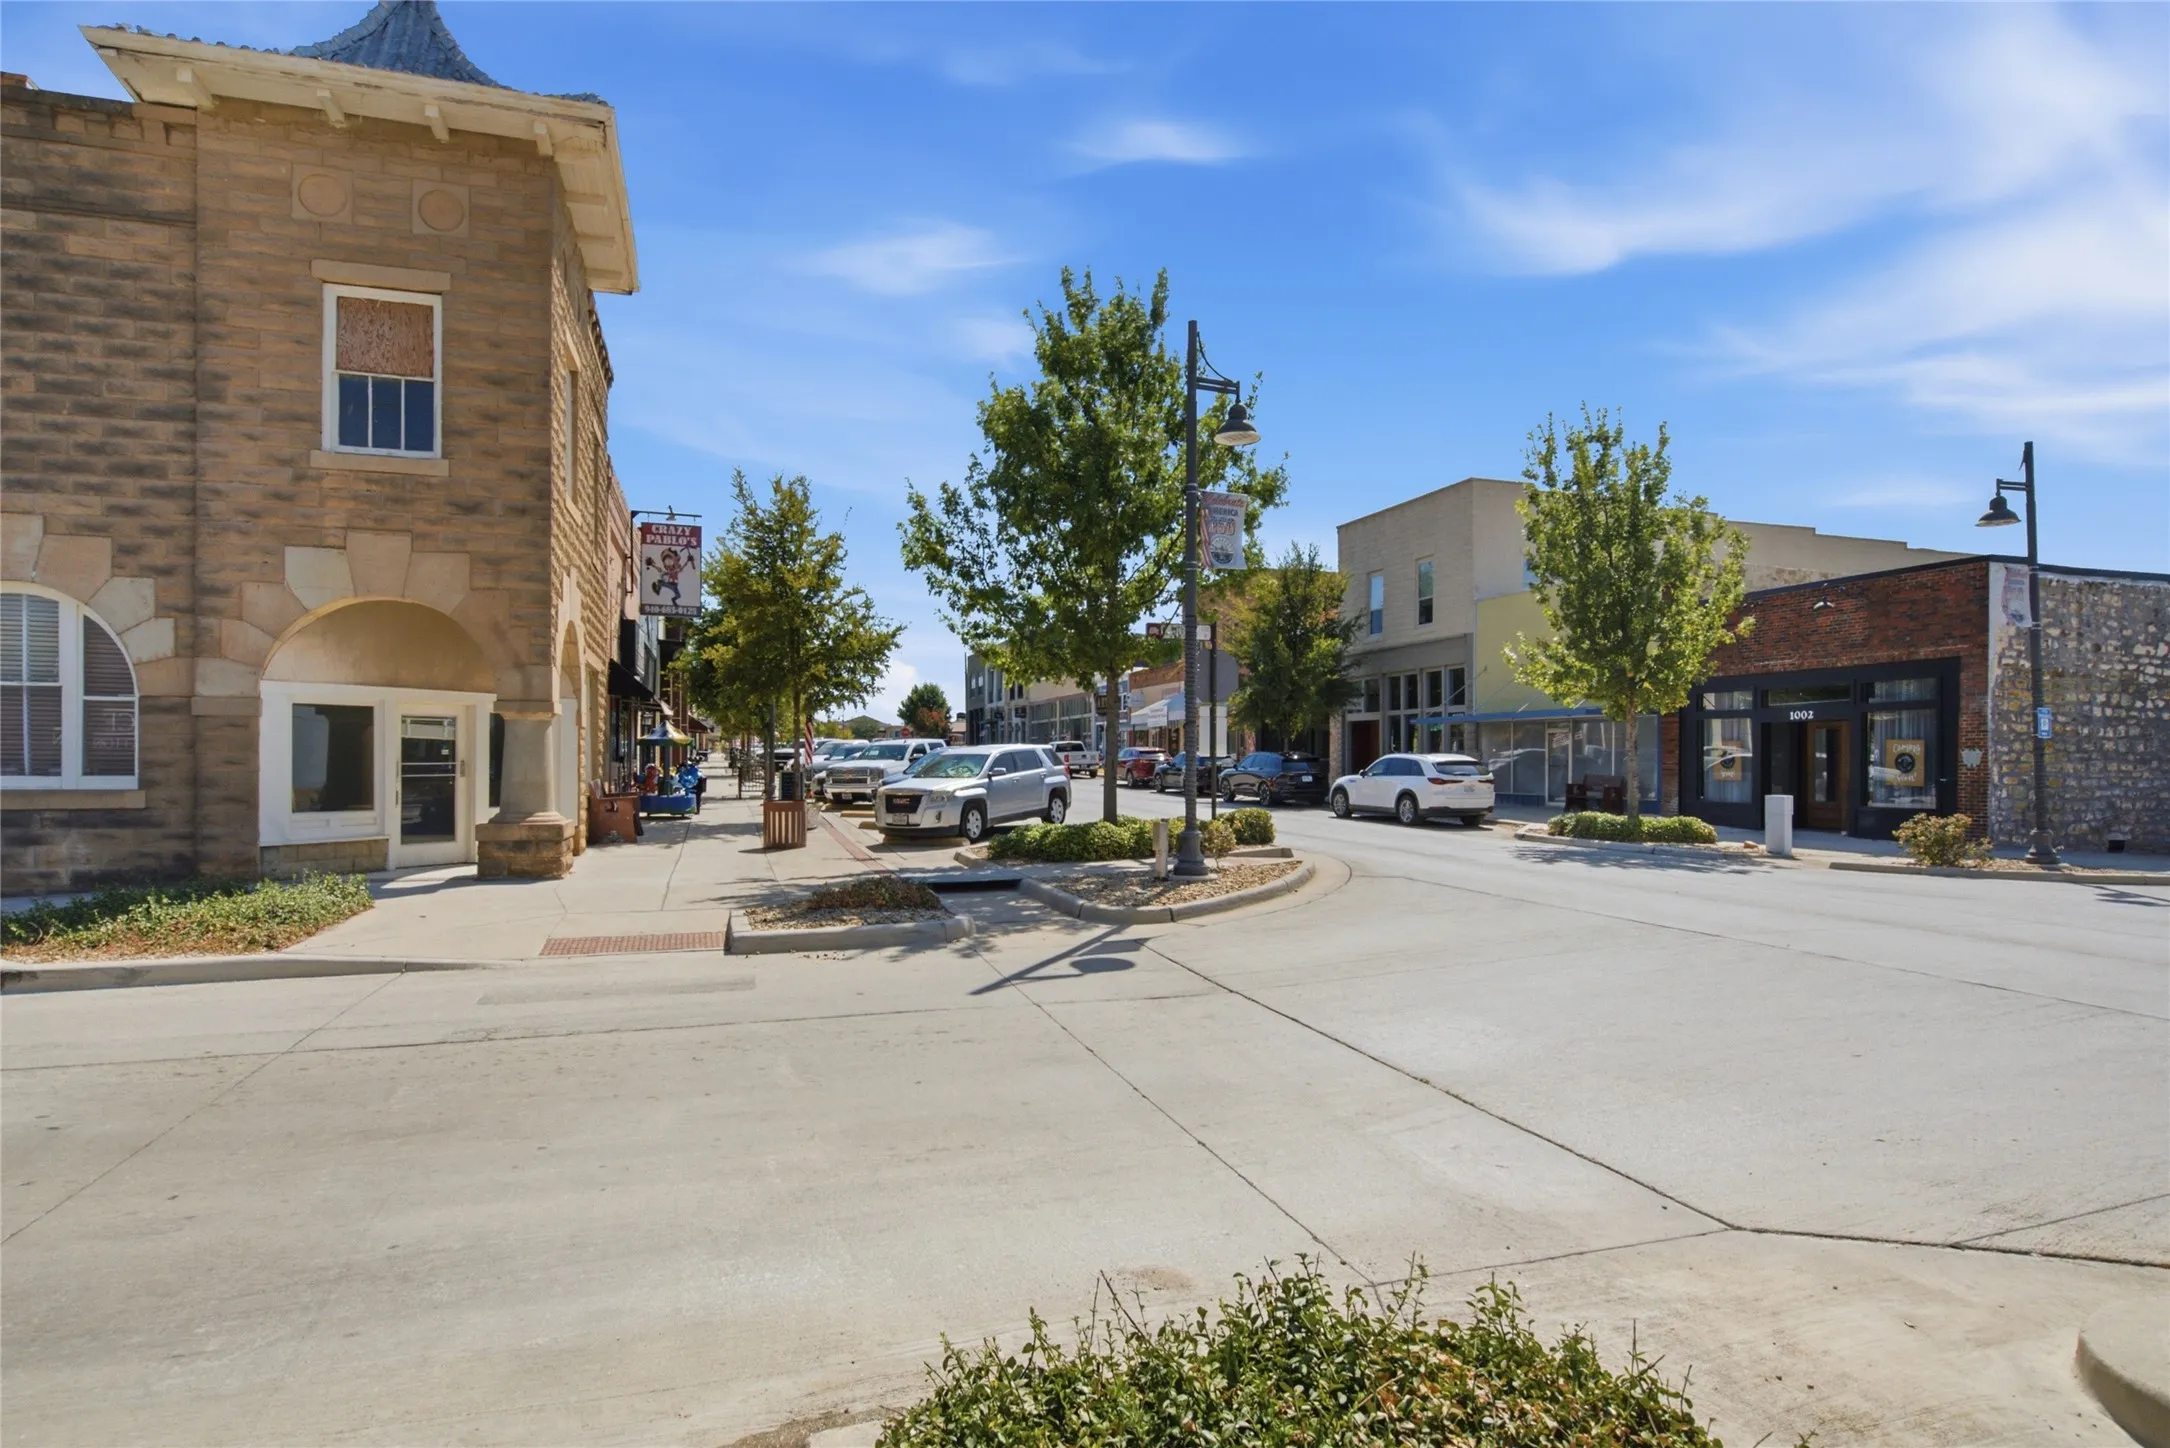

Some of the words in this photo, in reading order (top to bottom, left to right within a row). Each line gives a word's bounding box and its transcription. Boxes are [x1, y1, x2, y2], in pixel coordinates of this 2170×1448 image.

[651, 524, 692, 536] CRAZY
[646, 534, 697, 546] PABLO'S
[1789, 710, 1815, 721] 1002
